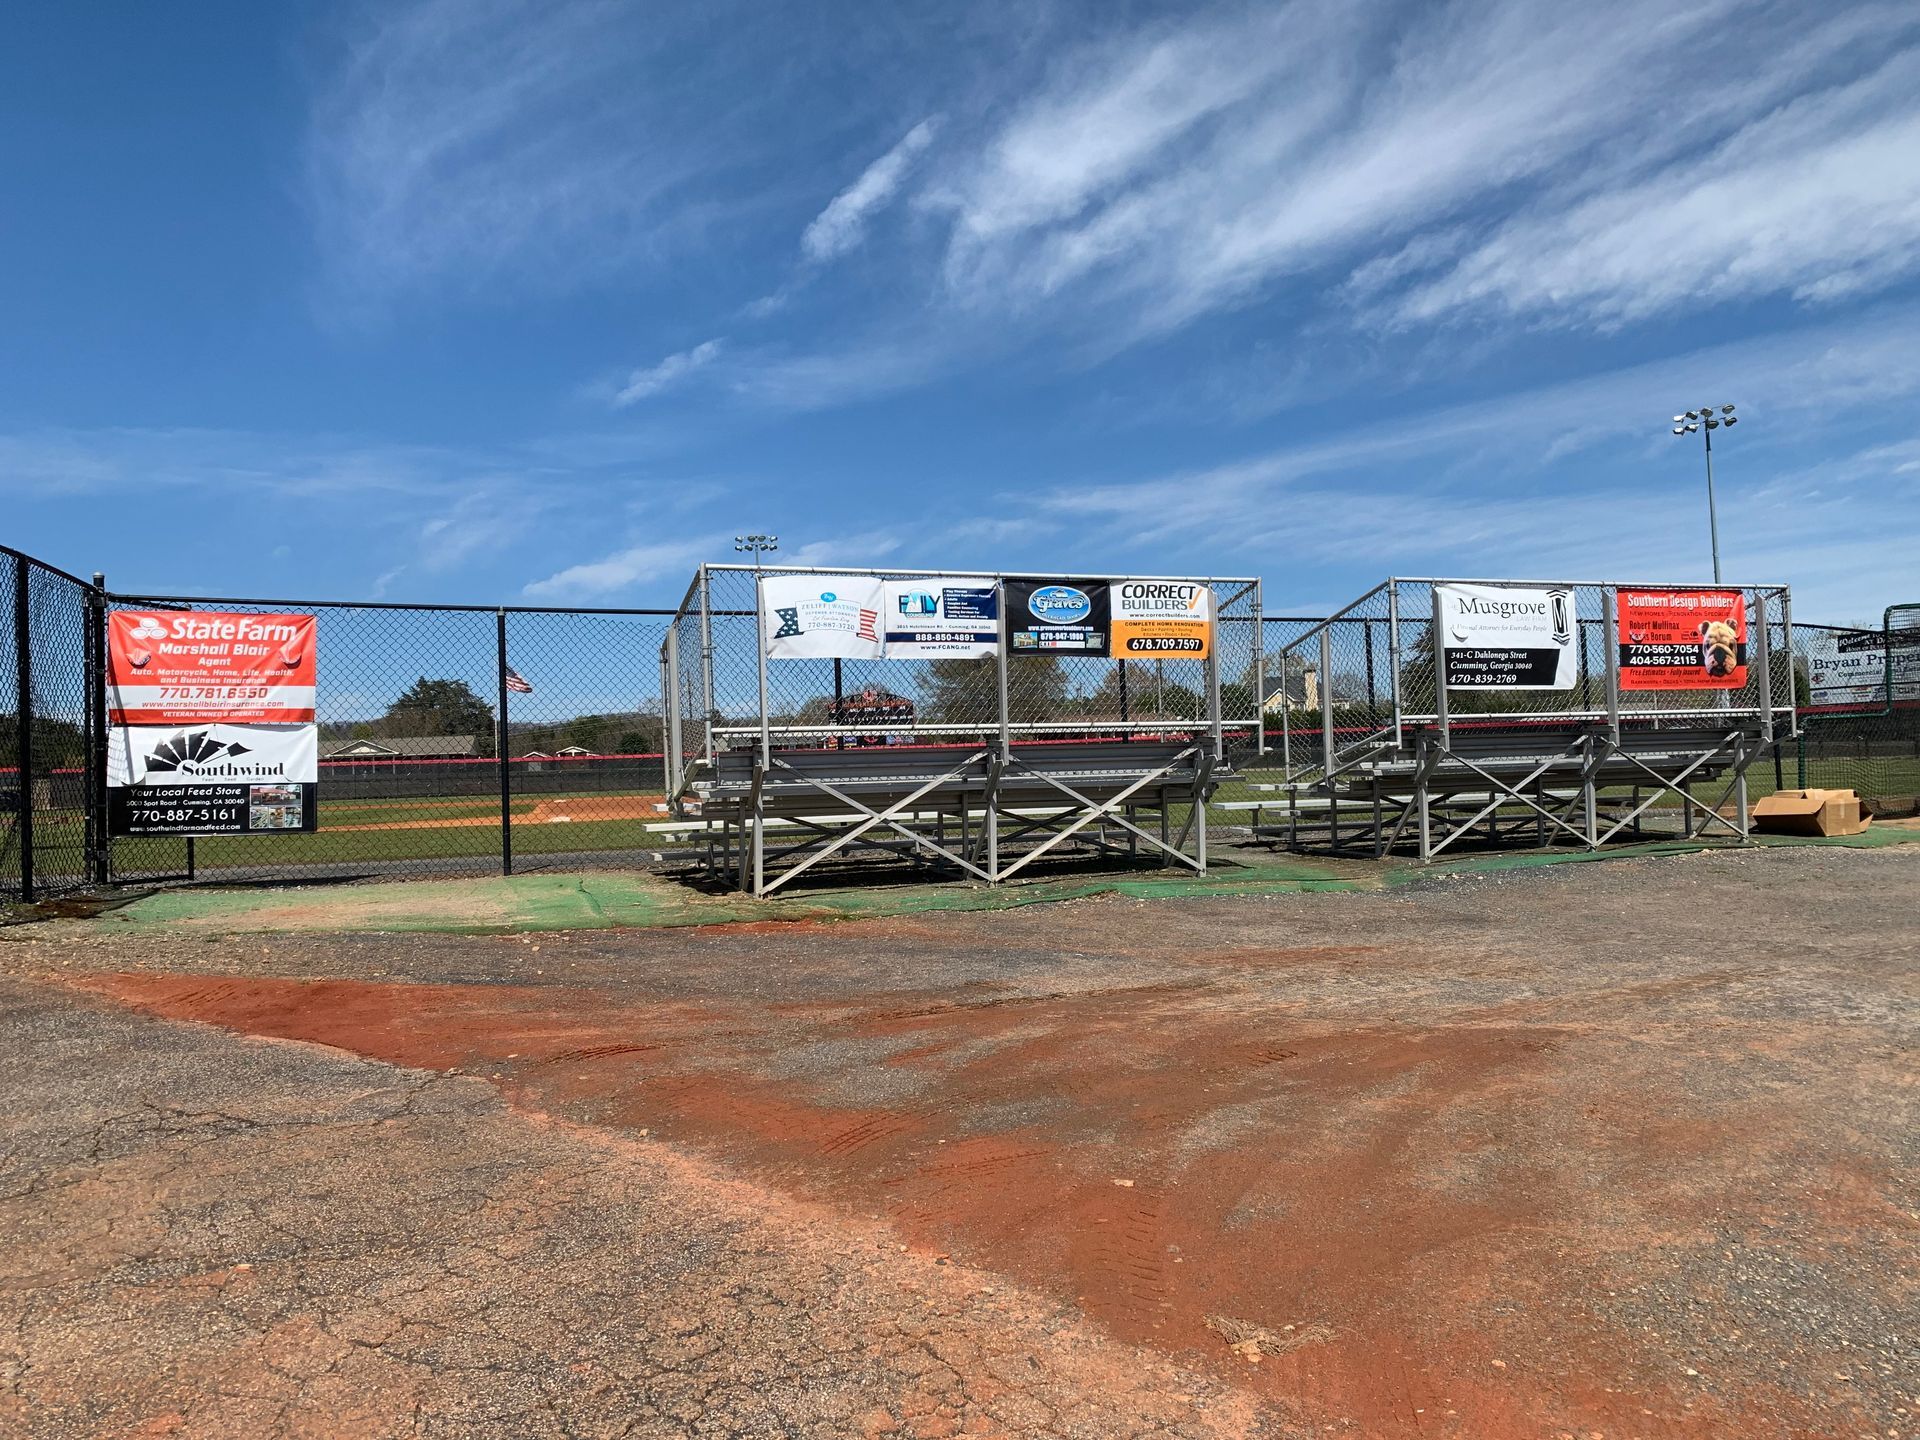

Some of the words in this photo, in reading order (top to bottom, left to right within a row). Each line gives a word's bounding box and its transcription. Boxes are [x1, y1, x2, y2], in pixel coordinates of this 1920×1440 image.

[1121, 584, 1196, 600] CORRECT
[1122, 599, 1188, 610] BUILDERS
[1458, 597, 1546, 618] Musgrove
[1627, 593, 1669, 608] Southern
[1669, 594, 1699, 611] Design
[1700, 595, 1734, 608] Builders
[170, 617, 235, 640] State
[237, 618, 297, 642] Farm
[1629, 620, 1651, 630] Robert
[1650, 632, 1672, 641] Borum
[158, 642, 230, 655] Marshall
[233, 643, 270, 656] Blair
[1132, 639, 1200, 650] 678.709.7597
[1629, 645, 1699, 654] 770-560-7054
[1450, 651, 1473, 659] 341-C
[1474, 651, 1509, 660] Dahlonega
[1510, 651, 1527, 659] Street
[1629, 656, 1697, 665] 404-567-2115
[198, 657, 231, 666] Agent
[1450, 661, 1489, 672] Cumming,
[1490, 661, 1514, 671] Georgia
[1812, 657, 1862, 671] Bryan
[1629, 668, 1641, 676] Free
[160, 676, 177, 684] and
[180, 676, 221, 684] Business
[223, 676, 267, 684] Insurance
[1449, 674, 1517, 684] 470-839-2769
[159, 687, 269, 699] 770.781.6550
[181, 762, 284, 777] Southwind
[131, 787, 153, 797] Your
[156, 787, 185, 796] Local
[187, 787, 212, 796] Feed
[215, 786, 242, 795] Store
[132, 808, 236, 822] 770-887-5161
